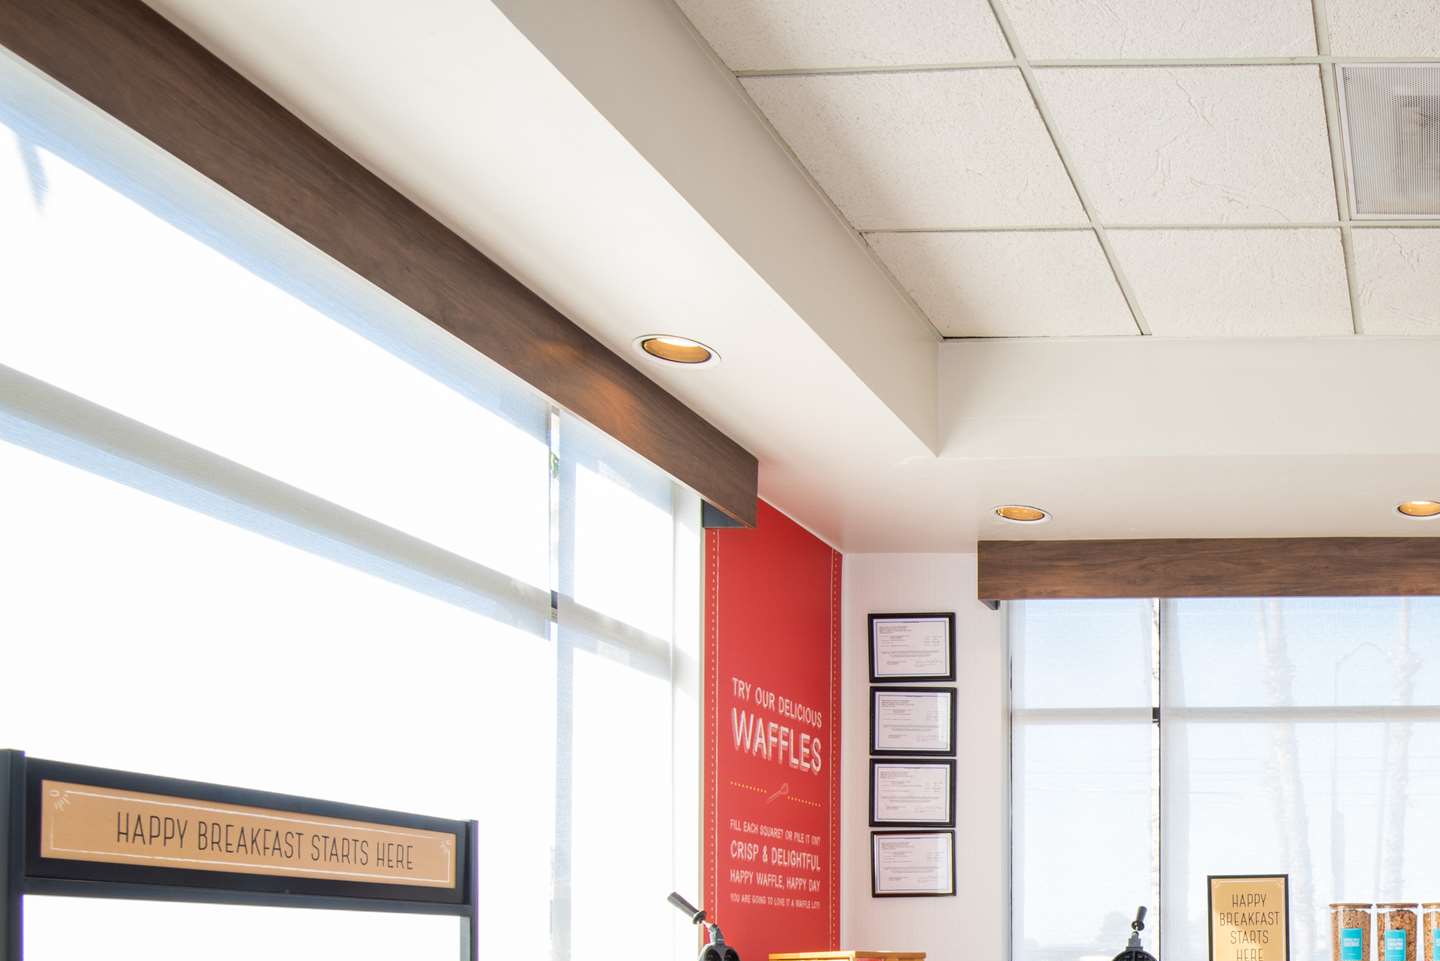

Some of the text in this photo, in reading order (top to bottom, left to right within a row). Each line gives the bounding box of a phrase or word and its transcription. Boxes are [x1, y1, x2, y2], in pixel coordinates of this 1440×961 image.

[732, 676, 822, 728] TRY OUR DELICIOUS
[731, 706, 822, 776] WAFFLES
[116, 811, 414, 870] HAPPY BREAKFAST STARTS HERE
[730, 818, 741, 831] FILL
[743, 821, 758, 833] EACH
[785, 830, 793, 841] OR
[730, 839, 821, 871] CRISP & DELIGHTFUL
[730, 869, 821, 892] HAPPY WAFFLE, HAPPY DAY
[741, 894, 751, 904] ARE
[1231, 893, 1267, 908] HAPPY
[1219, 911, 1280, 926] BREAKFAST
[1230, 930, 1269, 944] STARTS
[1236, 948, 1264, 961] HERE
